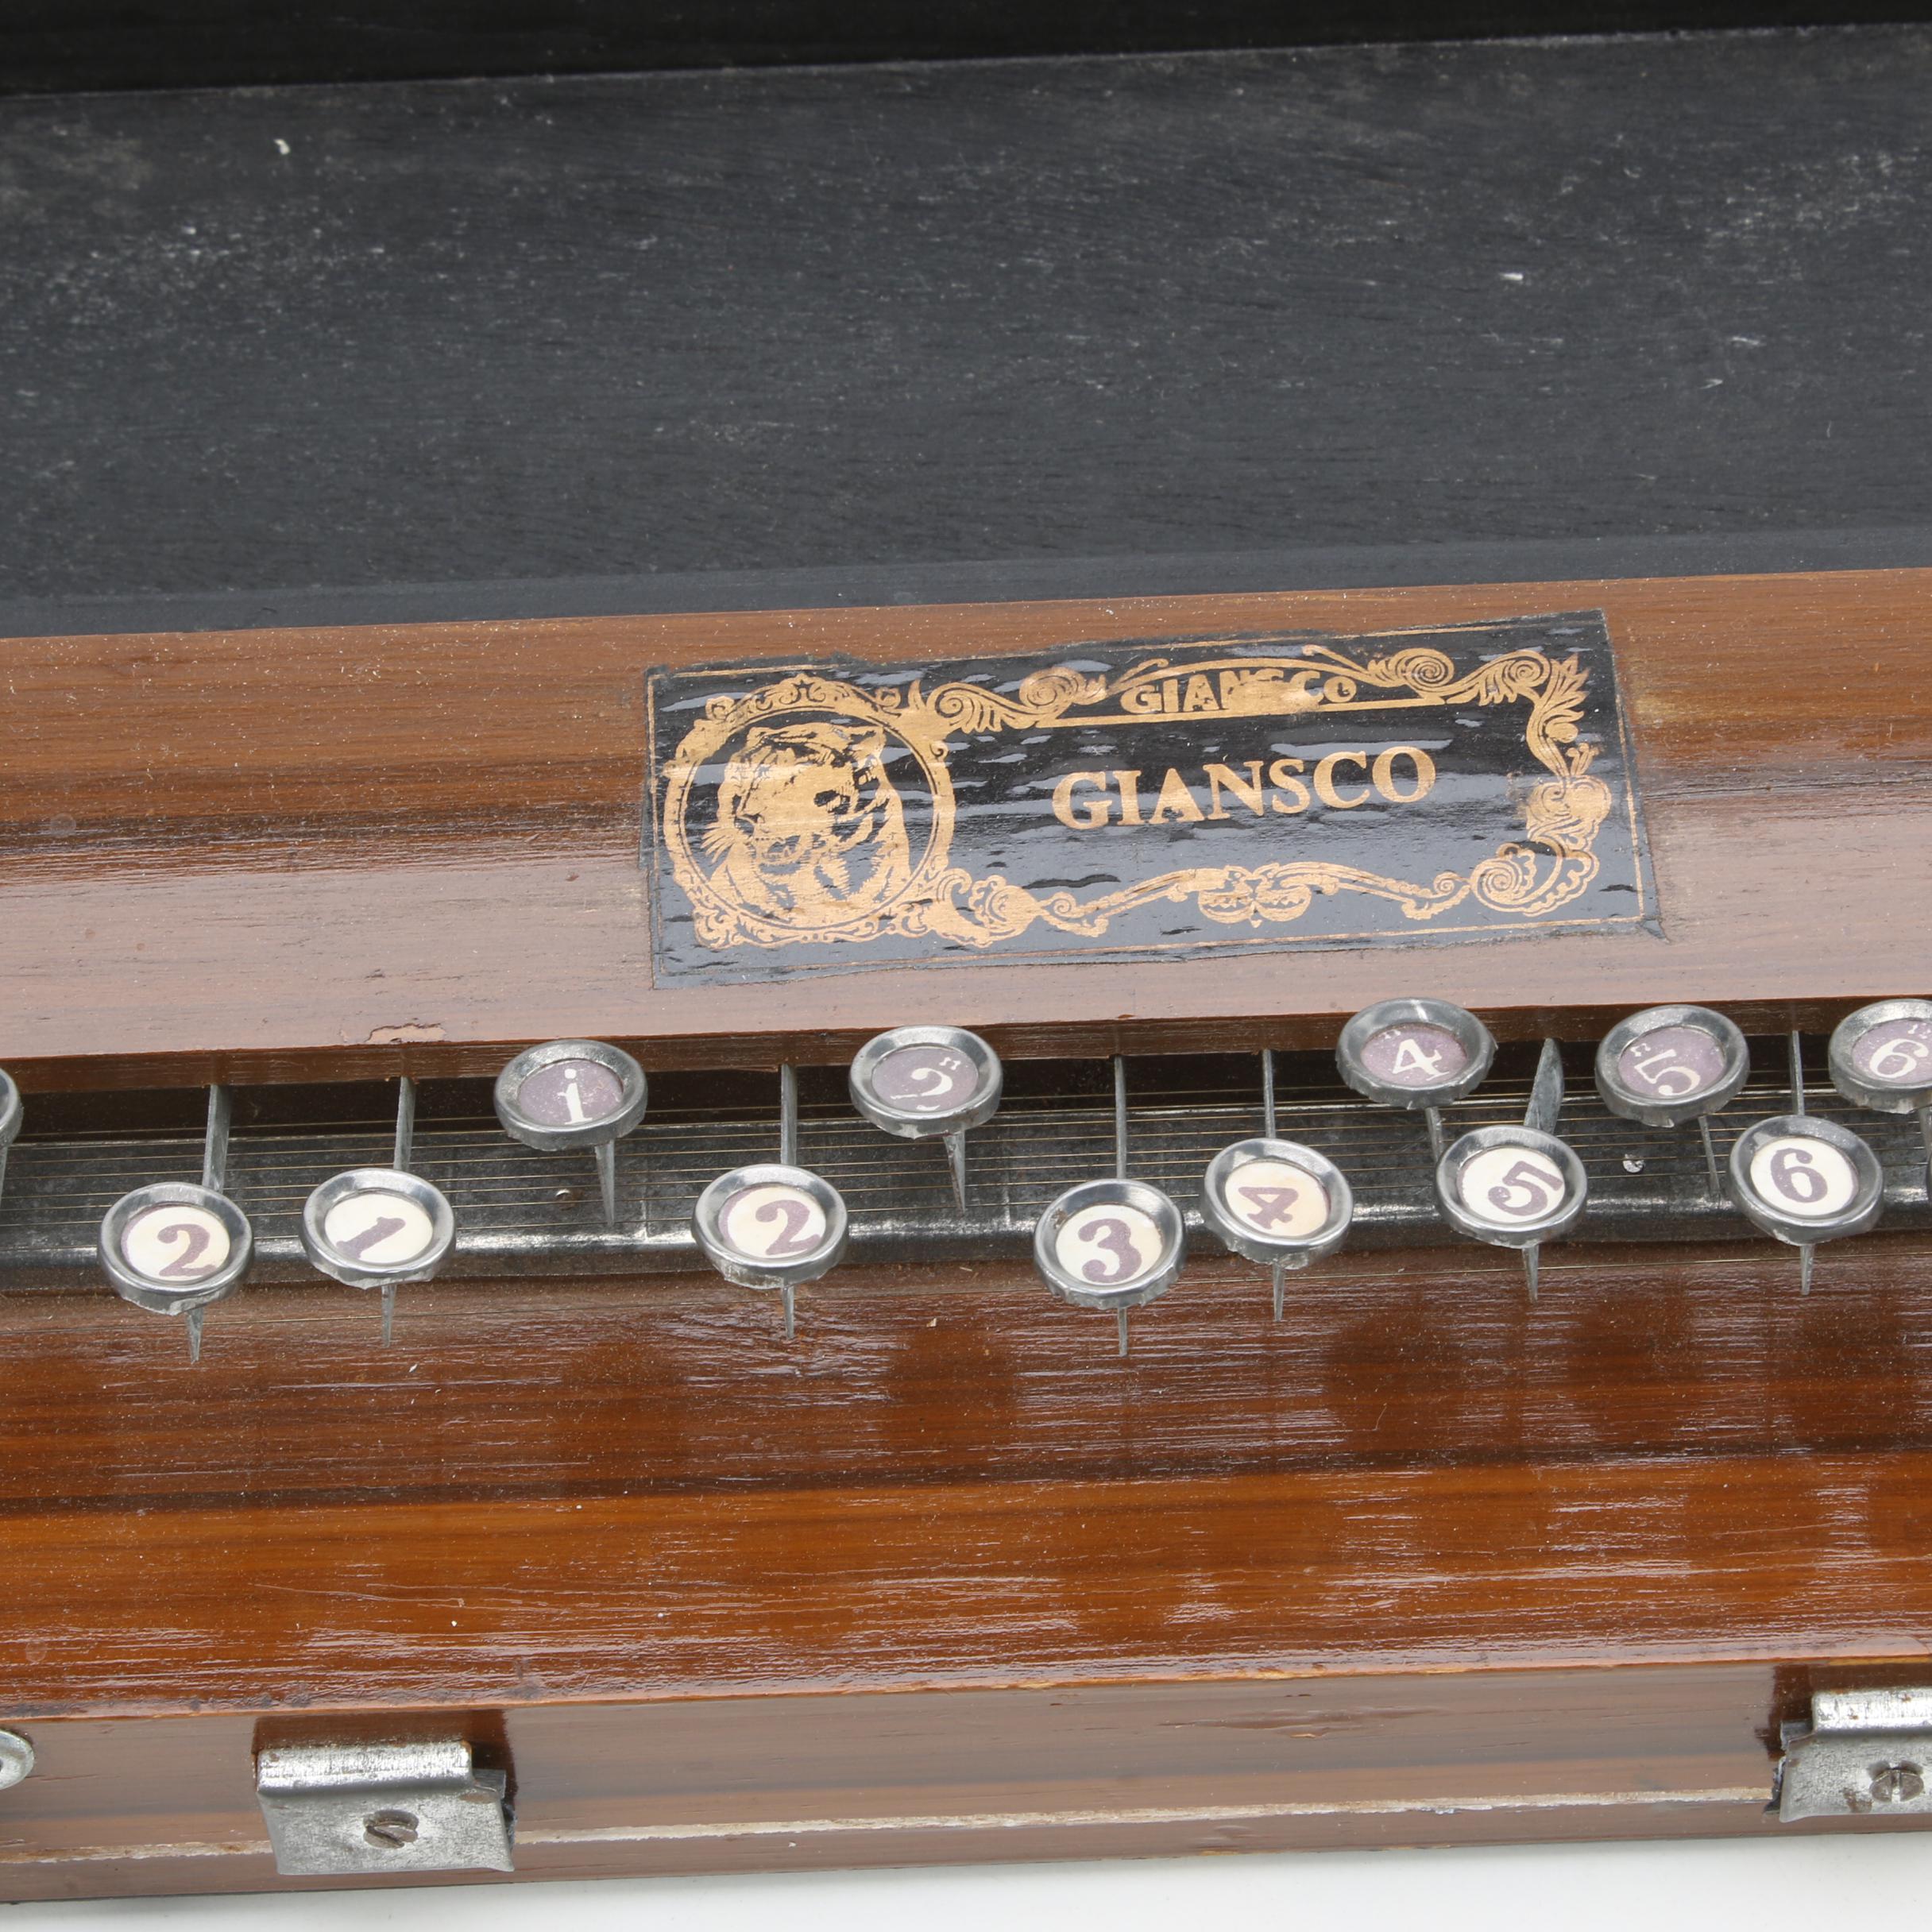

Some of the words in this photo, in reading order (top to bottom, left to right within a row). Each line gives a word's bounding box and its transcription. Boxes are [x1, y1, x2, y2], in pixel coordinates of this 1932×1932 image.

[1051, 745, 1436, 831] GIANSCO
[1392, 1038, 1450, 1081] 4
[1634, 1049, 1701, 1095] 5
[1869, 1038, 1929, 1079] 6
[1487, 1160, 1563, 1216] 5
[1770, 1147, 1828, 1204] 6
[755, 1200, 821, 1256] 2
[1238, 1186, 1299, 1230] 4
[156, 1223, 215, 1277] 2
[336, 1215, 406, 1258] 1
[1077, 1218, 1142, 1284] 3
